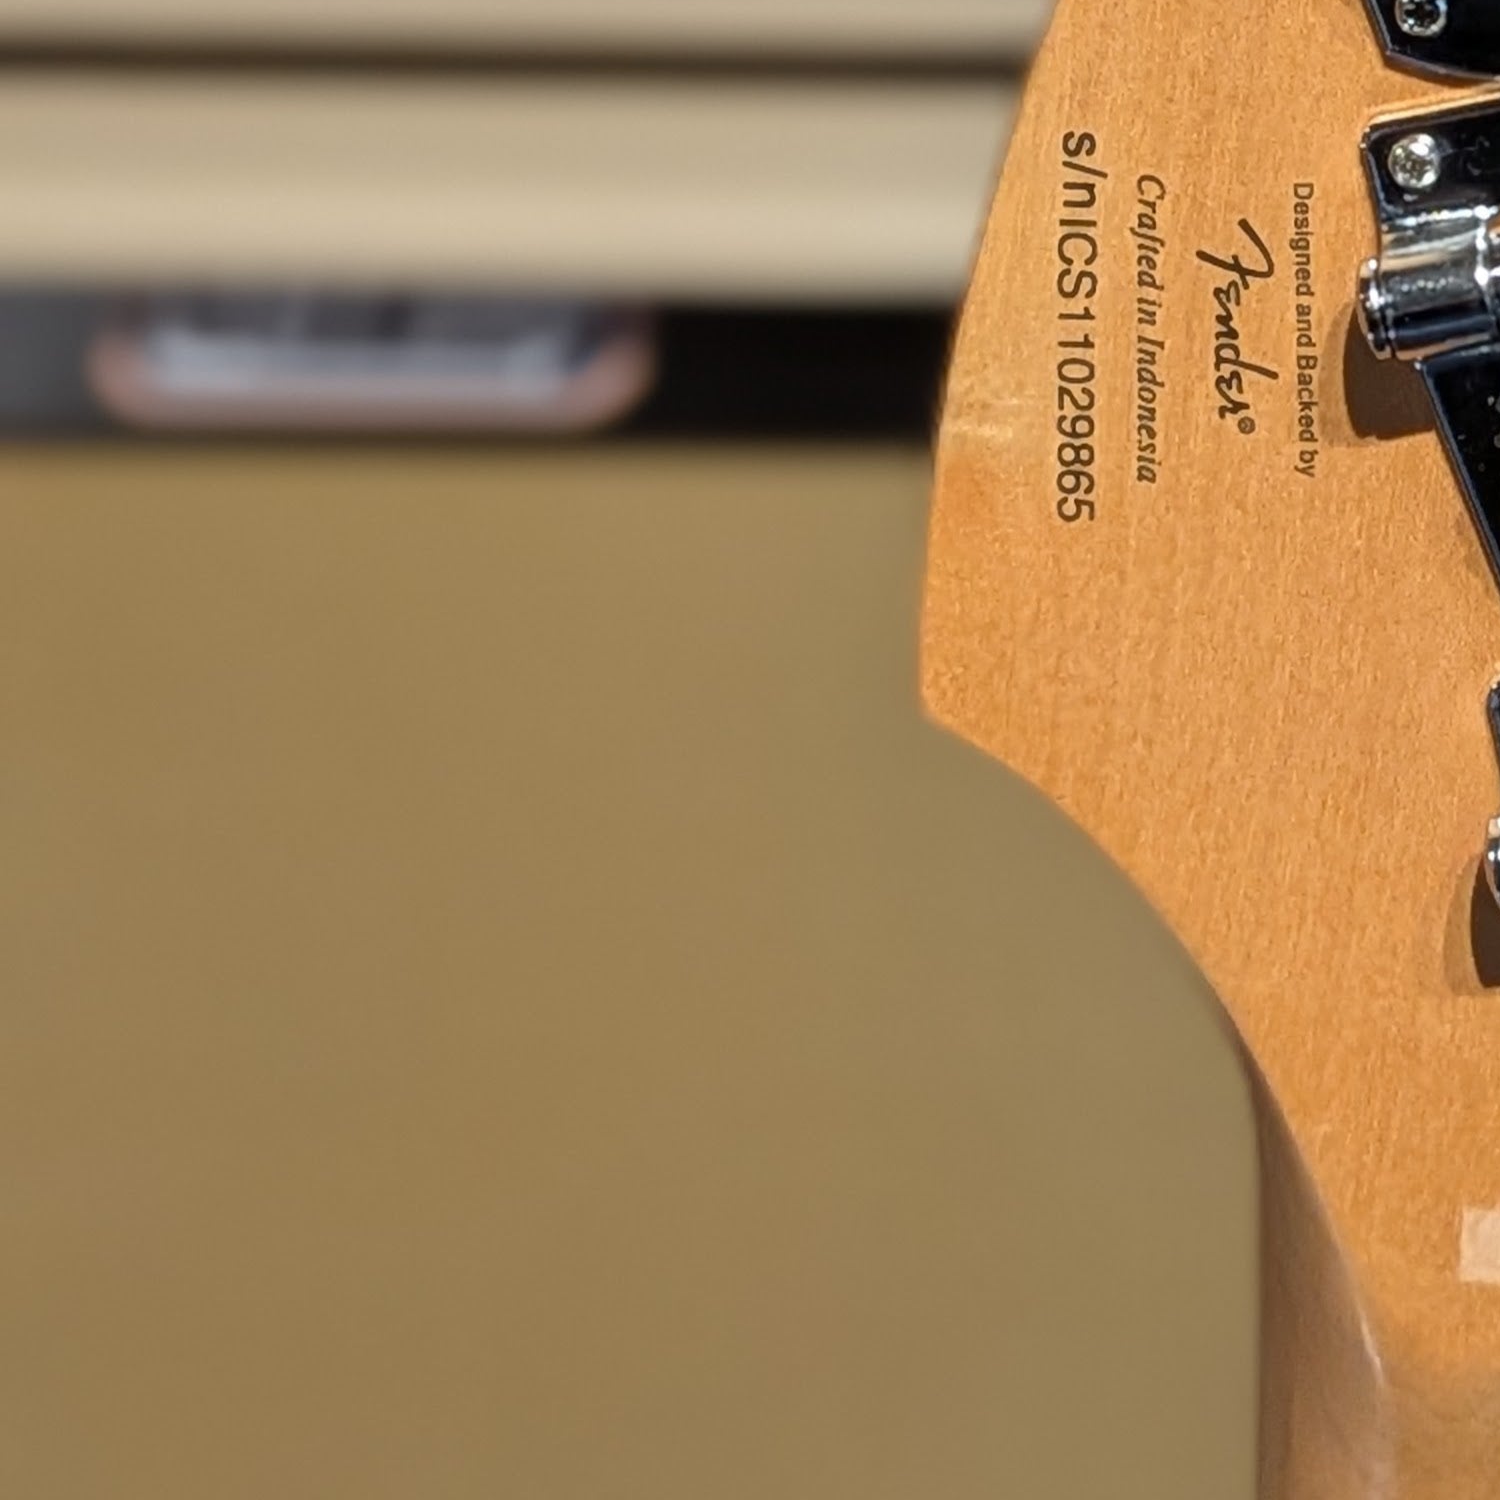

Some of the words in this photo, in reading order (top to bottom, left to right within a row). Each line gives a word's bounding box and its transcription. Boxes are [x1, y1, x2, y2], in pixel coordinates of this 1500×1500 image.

[1129, 173, 1166, 291] Crafted
[1290, 182, 1316, 297] Designed
[1137, 297, 1164, 326] in
[1295, 303, 1316, 348] and
[1136, 334, 1166, 485] Indonesia
[1297, 354, 1320, 444] Backed
[1294, 450, 1320, 479] by
